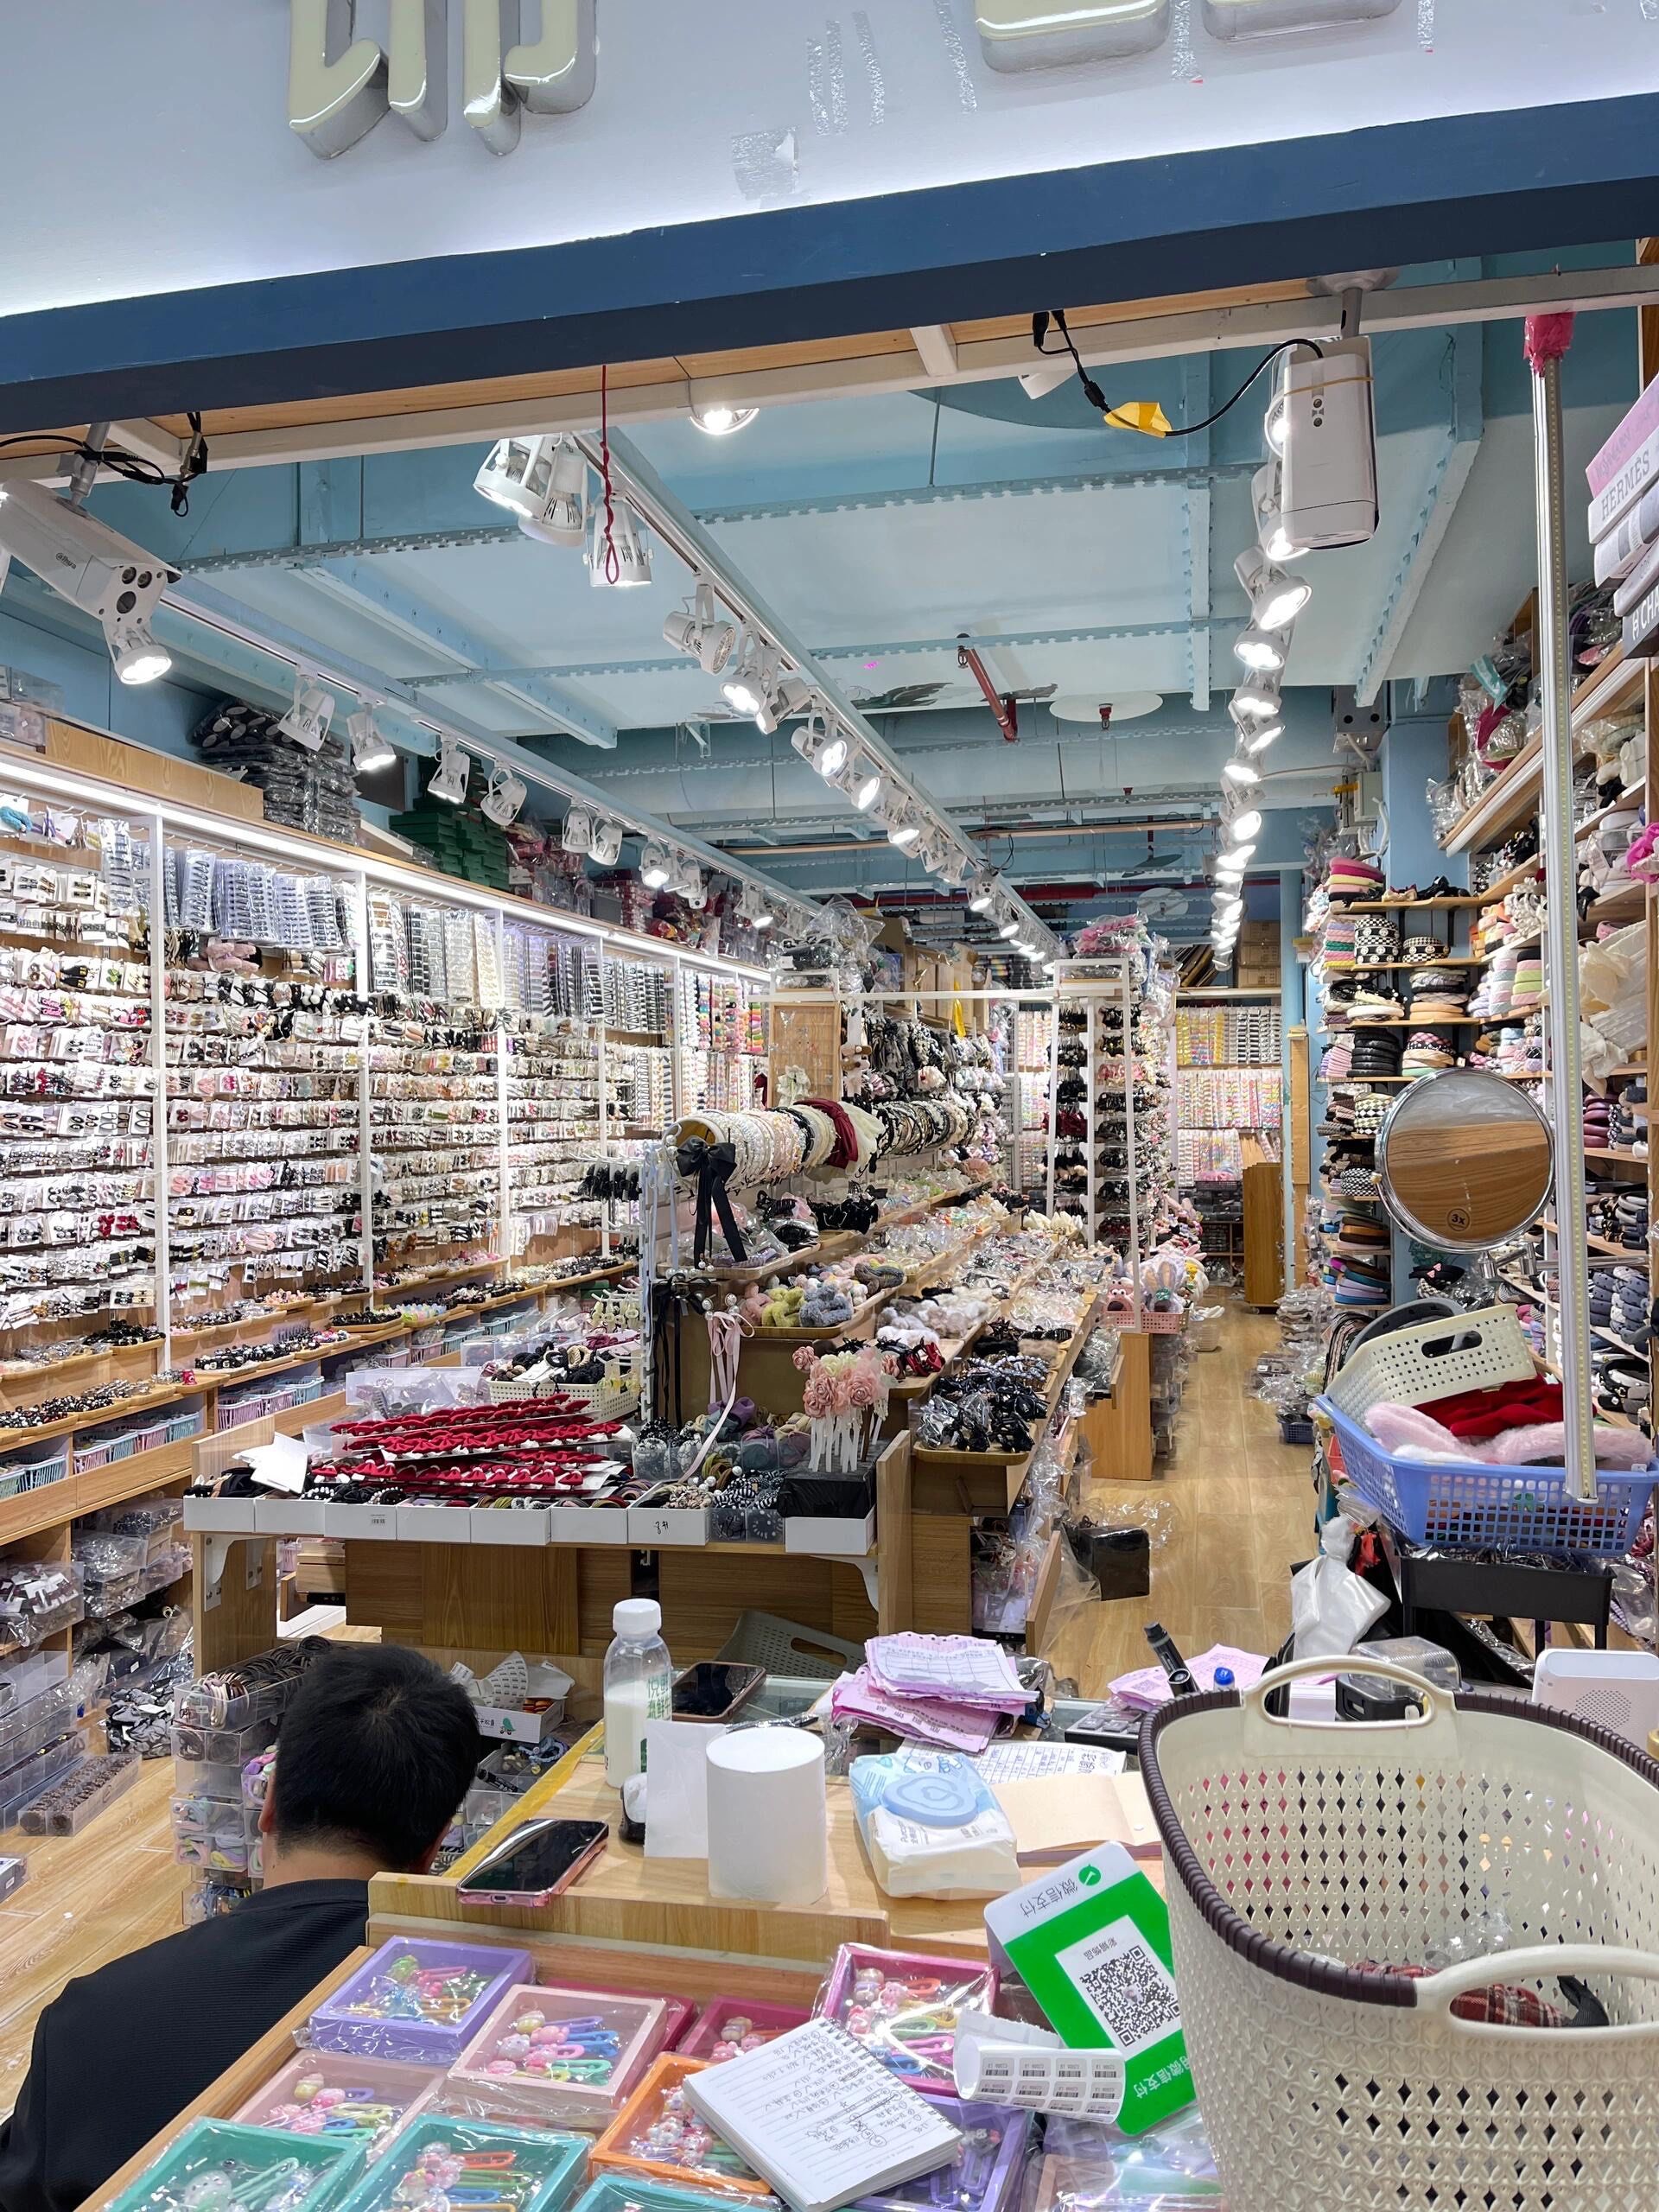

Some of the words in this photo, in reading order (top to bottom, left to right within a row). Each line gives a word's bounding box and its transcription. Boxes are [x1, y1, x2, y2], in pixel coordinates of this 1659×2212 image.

[1451, 1213, 1465, 1225] 3x
[1020, 1876, 1078, 1917] 微信支付
